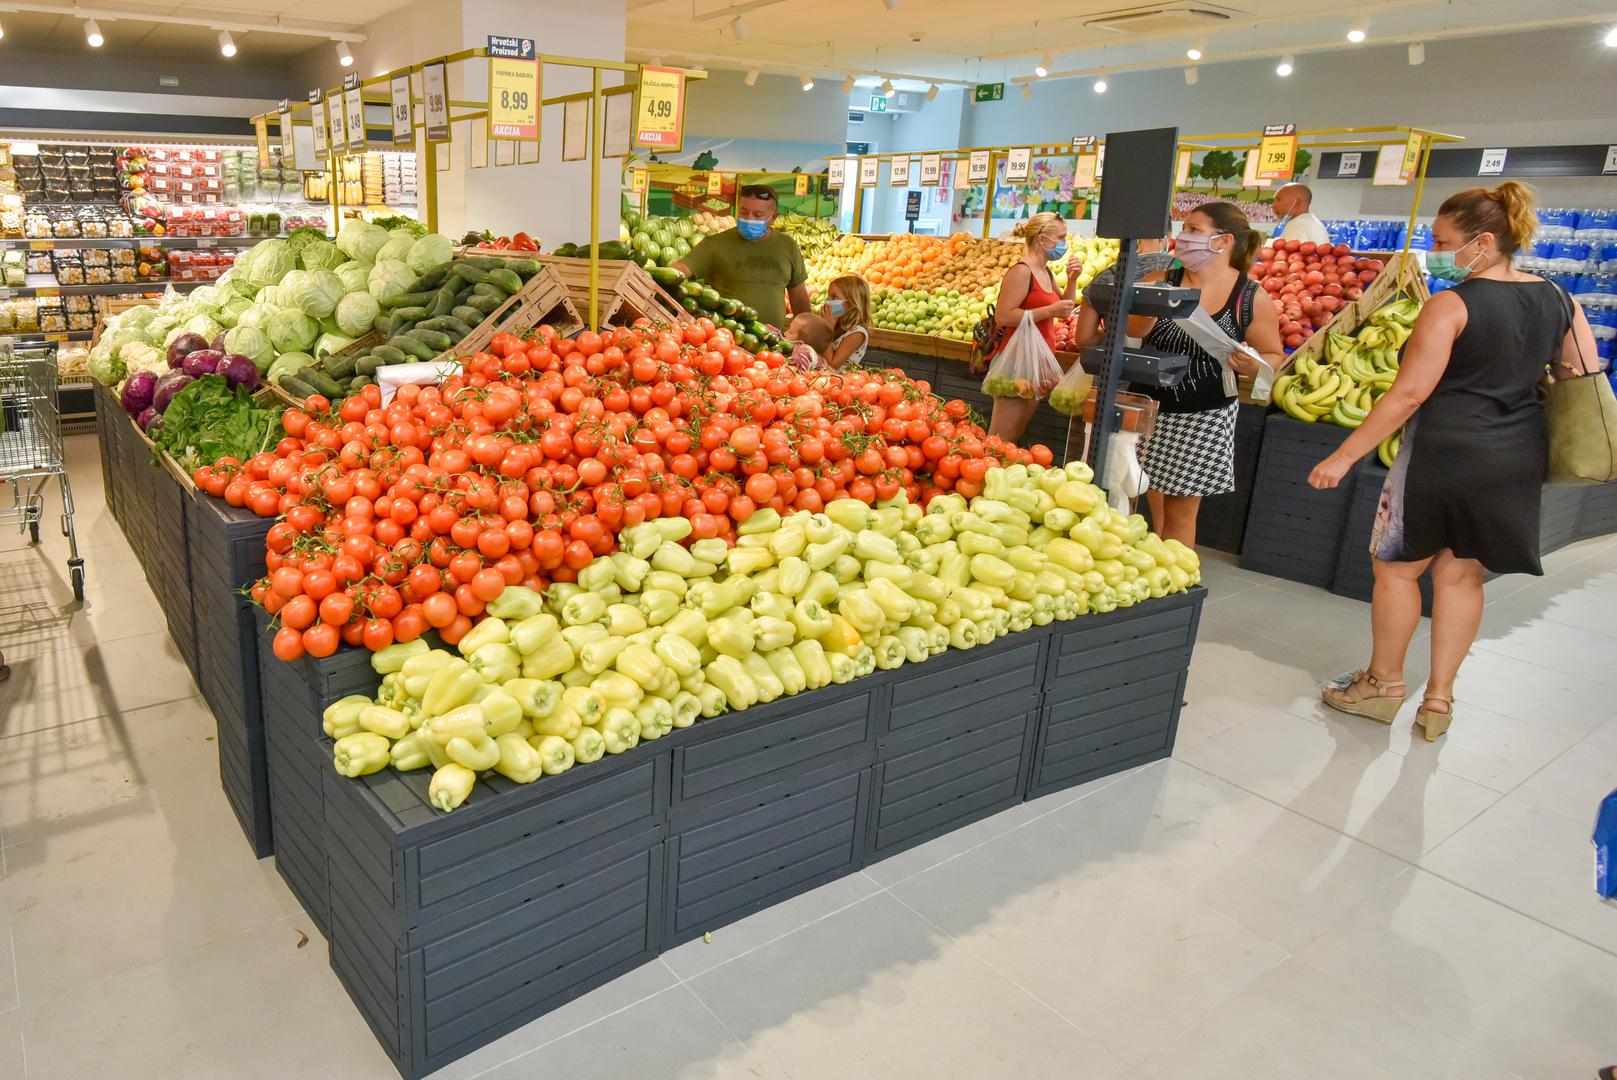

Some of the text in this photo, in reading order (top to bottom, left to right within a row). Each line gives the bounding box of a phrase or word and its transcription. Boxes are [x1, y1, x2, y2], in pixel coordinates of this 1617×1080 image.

[491, 46, 518, 56] Proizvod
[501, 90, 528, 111] 8,99
[648, 99, 671, 118] 4,99
[494, 125, 520, 136] AKCIJA
[640, 132, 661, 141] AKCIJA
[1267, 152, 1286, 163] 7,99
